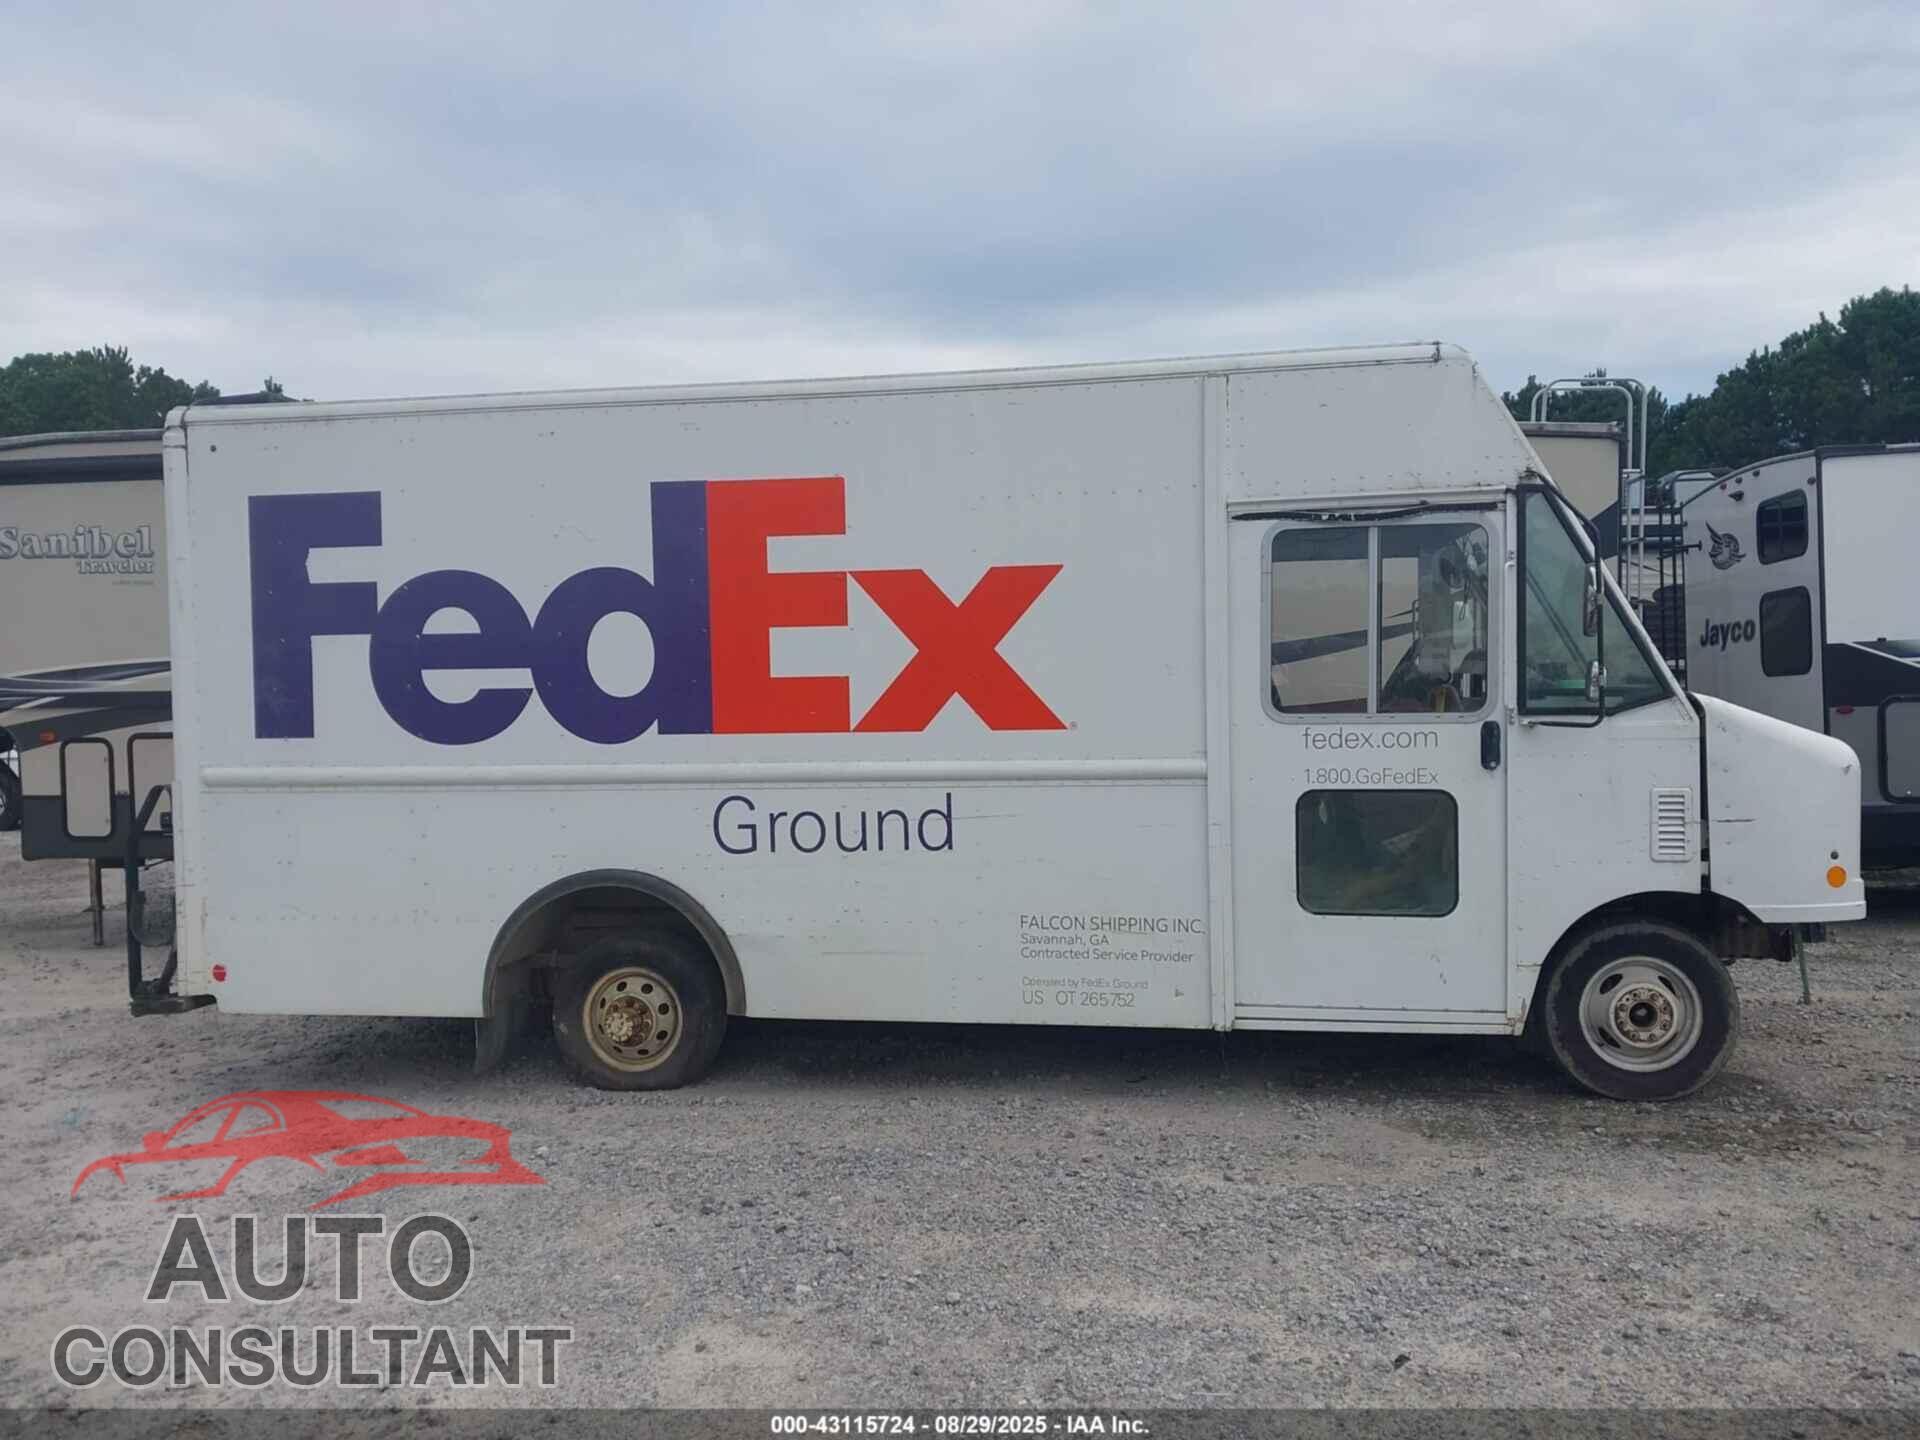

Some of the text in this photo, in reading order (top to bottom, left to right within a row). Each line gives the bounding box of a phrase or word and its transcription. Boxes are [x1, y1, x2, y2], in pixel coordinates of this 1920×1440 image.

[0, 525, 154, 560] Sanibel
[78, 560, 153, 574] Traveler
[248, 476, 1067, 745] FedEx
[1700, 618, 1756, 651] Jayco
[1302, 727, 1439, 749] fedex.com
[1304, 768, 1439, 785] 1.800.GoFedEx
[712, 792, 954, 855] Ground
[1019, 915, 1086, 931] FALCON
[1089, 916, 1168, 933] SHIPPING
[1020, 933, 1110, 945] Savannah, GA
[1020, 947, 1193, 962] Contracted Service Provider
[1067, 977, 1079, 988] by
[1080, 977, 1111, 988] FedEx
[1112, 978, 1149, 990] Ground
[1022, 990, 1044, 1005] US
[1079, 991, 1135, 1007] 265752
